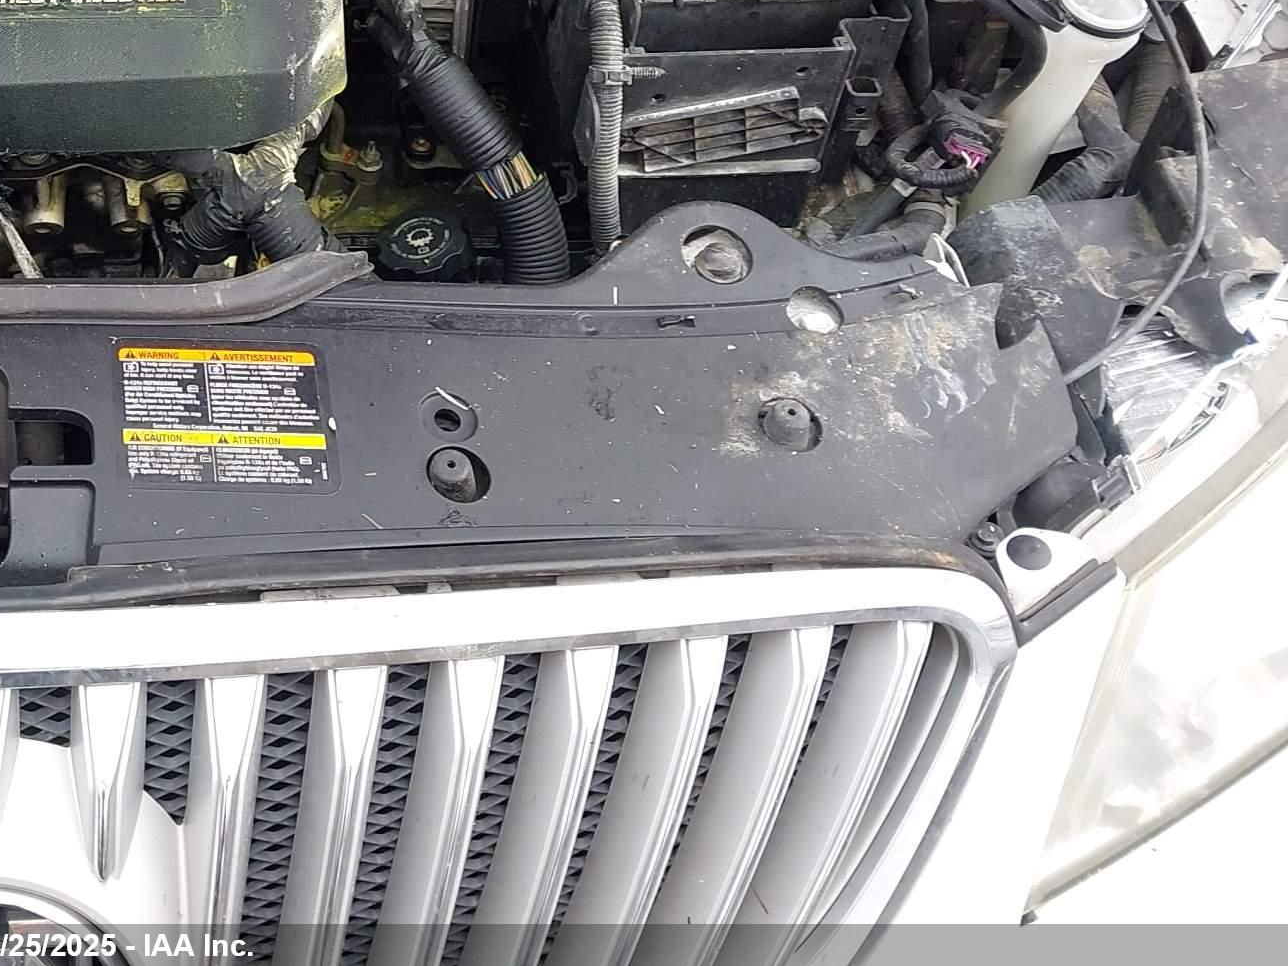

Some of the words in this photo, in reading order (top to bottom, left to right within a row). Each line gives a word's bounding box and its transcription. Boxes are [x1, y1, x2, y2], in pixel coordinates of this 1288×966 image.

[136, 351, 180, 361] WARNING
[223, 353, 293, 363] AVERTISSEMENT
[143, 434, 182, 443] CAUTION
[232, 435, 281, 445] ATTENTION
